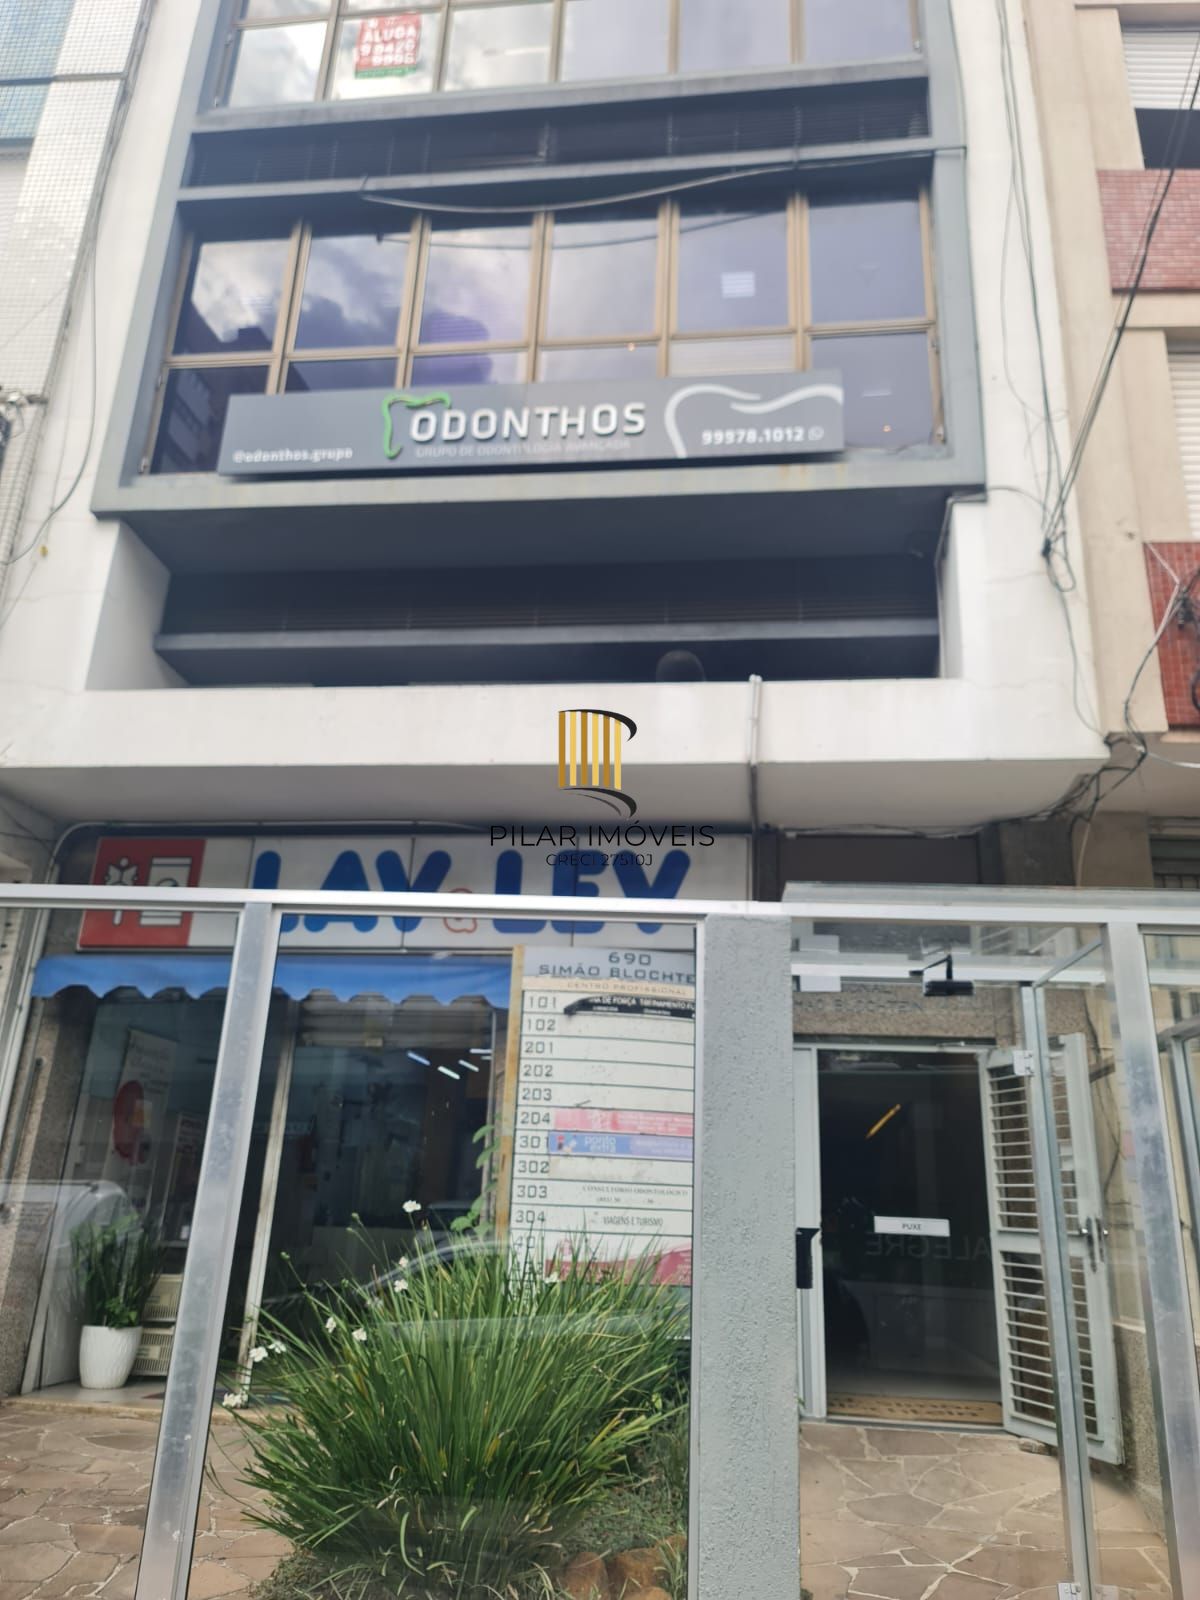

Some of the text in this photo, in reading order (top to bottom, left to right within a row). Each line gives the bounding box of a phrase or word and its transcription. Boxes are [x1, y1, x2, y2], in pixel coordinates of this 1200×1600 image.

[363, 25, 416, 43] ALUGA
[409, 402, 646, 441] ODONTHOS
[702, 427, 804, 445] 99978.1012
[232, 447, 353, 463] @odonthos.grupo
[416, 447, 457, 458] GRUPO
[459, 446, 475, 457] DE
[608, 952, 652, 966] 690
[538, 963, 601, 977] SIMÃO
[529, 996, 557, 1009] 101
[527, 1019, 556, 1031] 102
[524, 1041, 553, 1054] 201
[523, 1064, 553, 1077] 202
[522, 1087, 552, 1101] 203
[520, 1111, 550, 1125] 204
[517, 1160, 550, 1174] 302
[516, 1185, 548, 1199] 303
[515, 1210, 546, 1224] 304
[902, 1223, 922, 1231] PUXE
